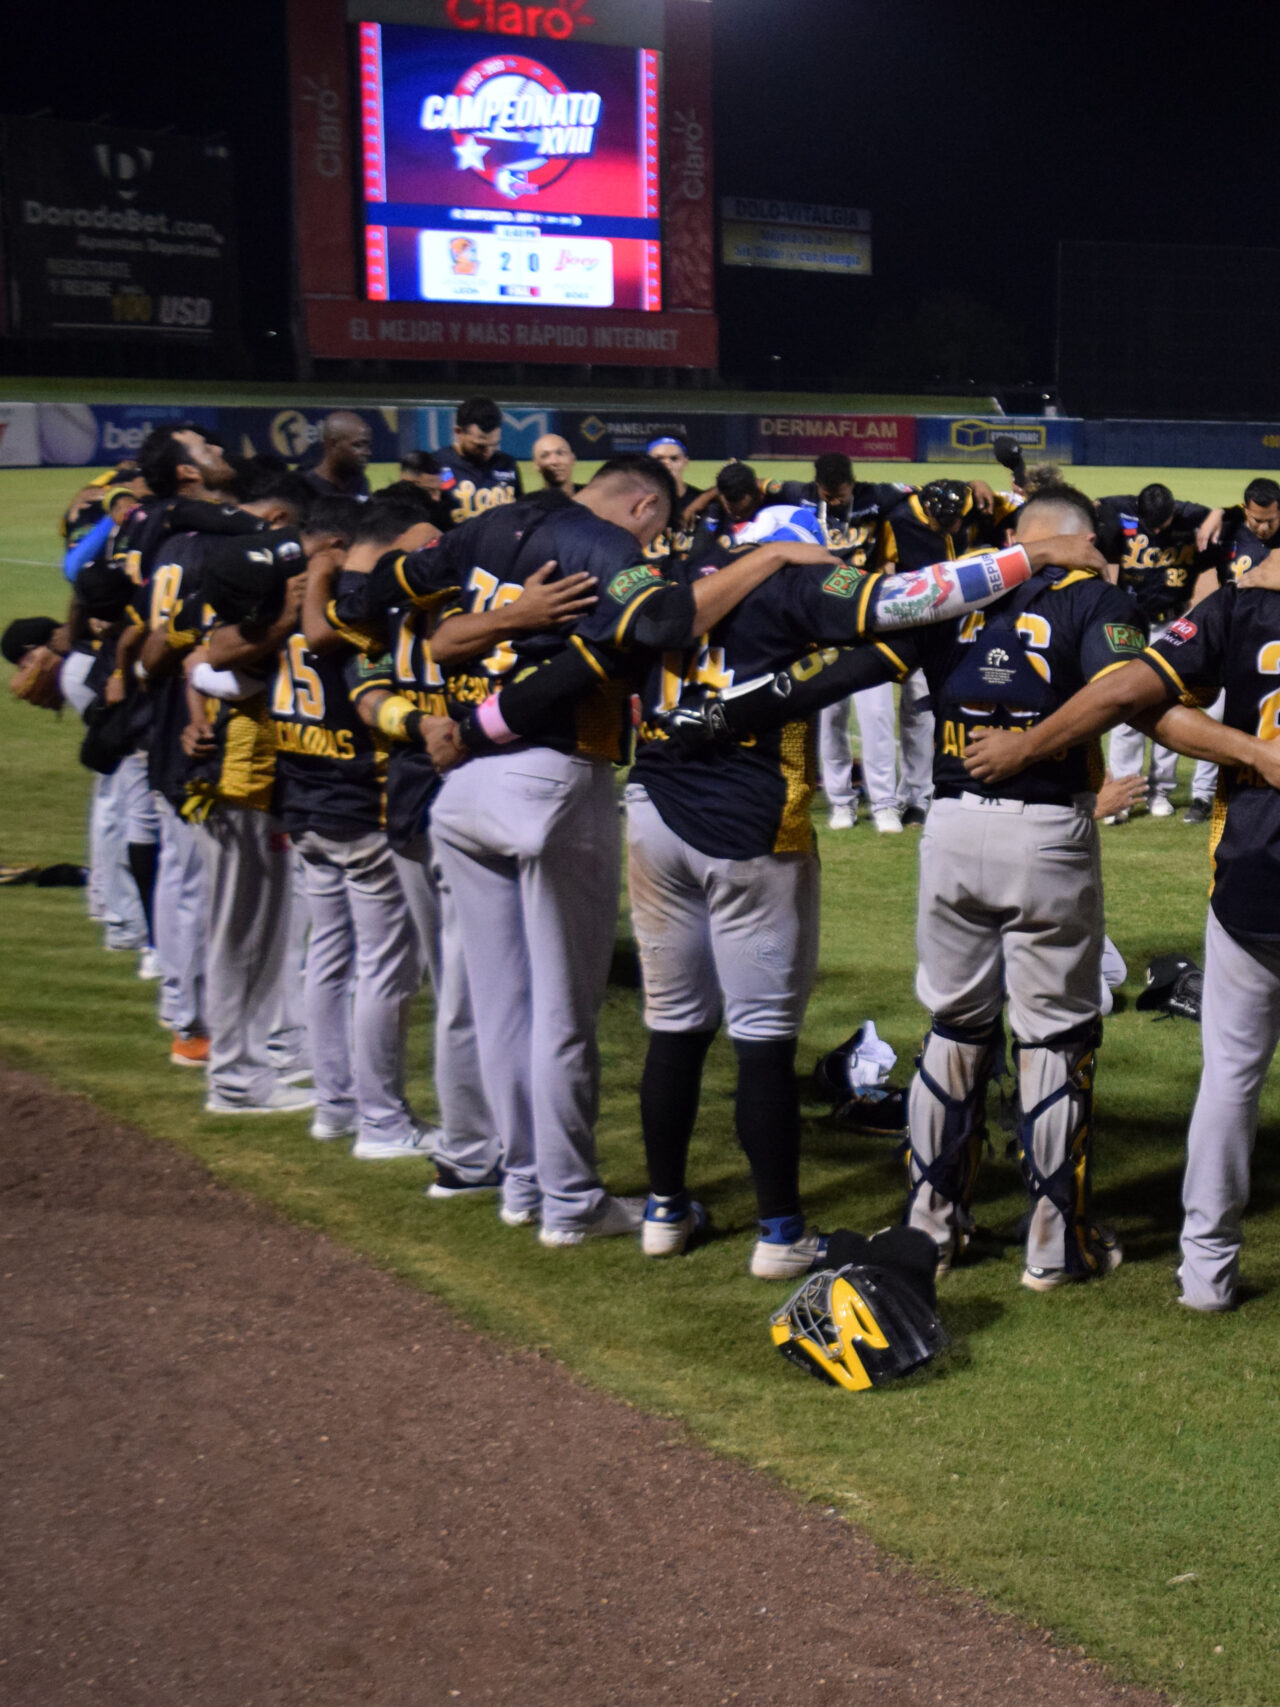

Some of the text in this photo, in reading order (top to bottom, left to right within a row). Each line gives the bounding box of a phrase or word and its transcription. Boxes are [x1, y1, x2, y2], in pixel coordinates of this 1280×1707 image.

[445, 0, 575, 40] Claro
[419, 91, 602, 131] CAMPEONATO
[315, 90, 344, 178] Claro
[536, 126, 595, 155] XVIII
[682, 121, 706, 200] Claro
[735, 199, 859, 226] DOLO-VITALGIA
[500, 252, 511, 271] 2
[528, 253, 540, 272] 0
[159, 295, 213, 326] USD
[350, 318, 680, 350] EL MEJOR Y MÁS RÁPIDO INTERNET
[760, 418, 898, 438] DERMAFLAM
[1164, 568, 1188, 588] 32
[271, 633, 325, 721] 15
